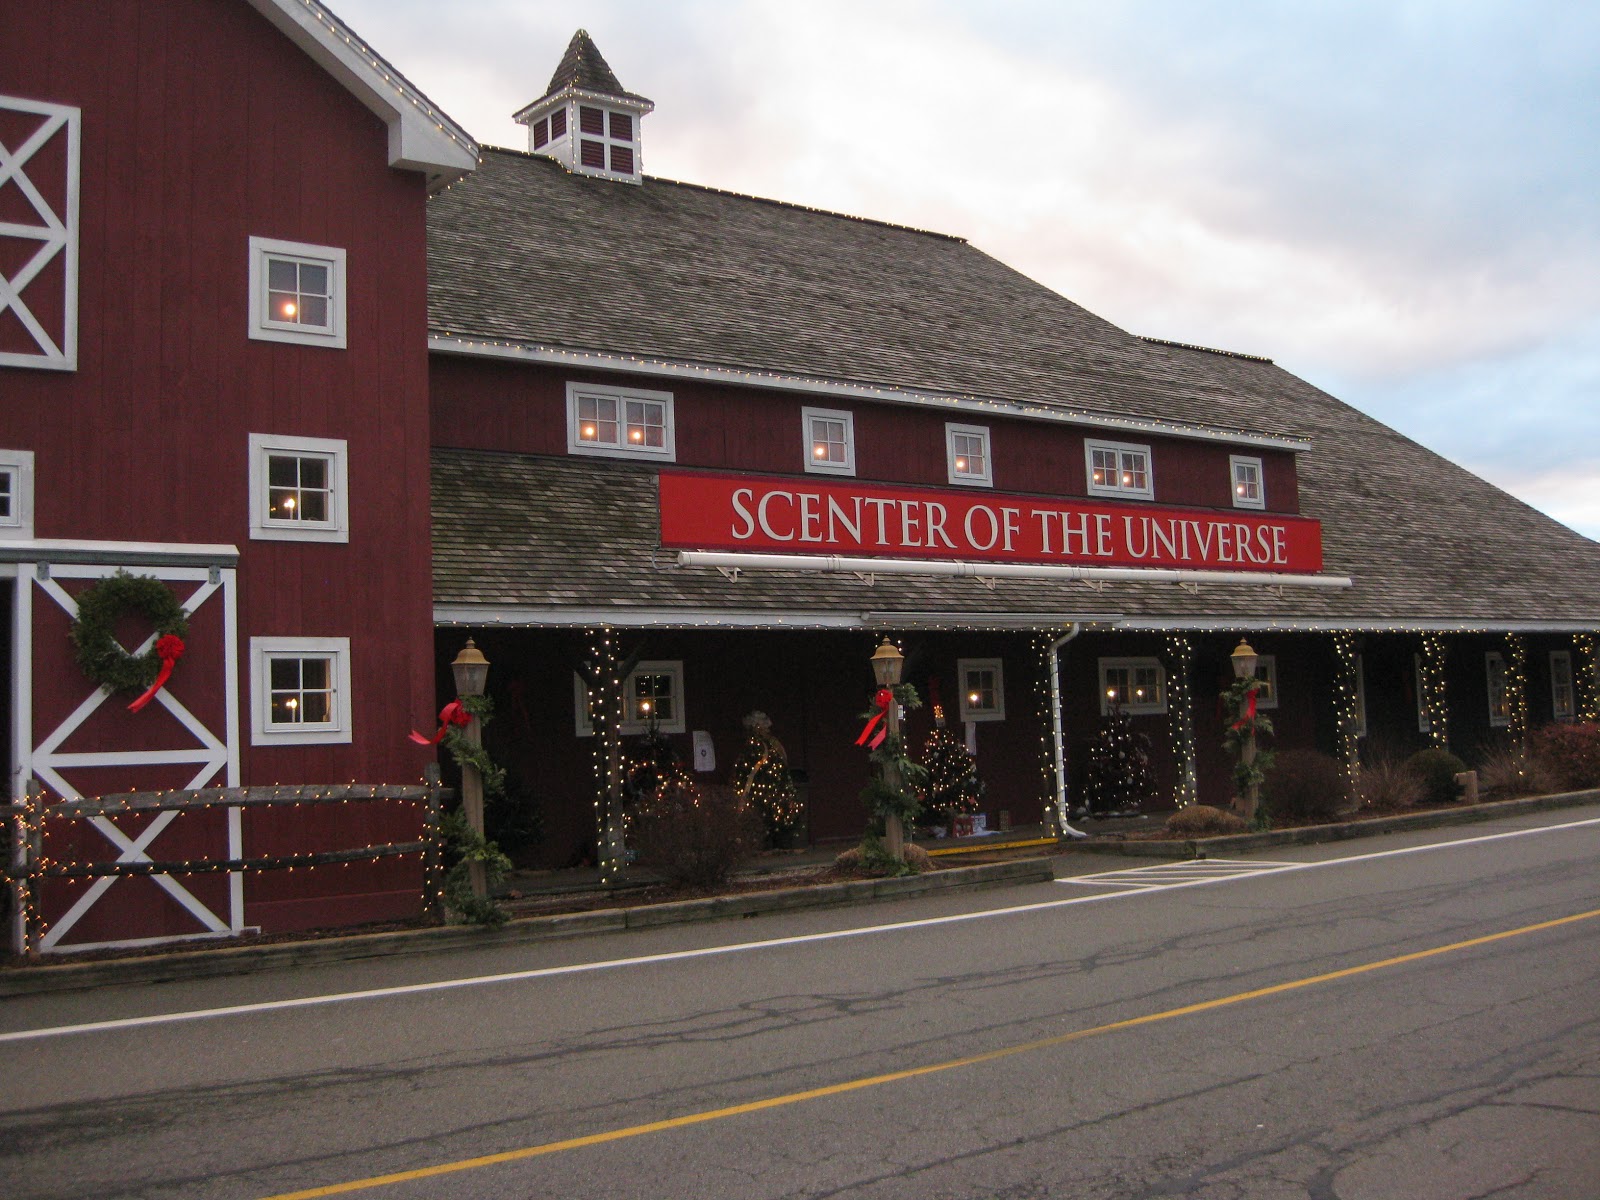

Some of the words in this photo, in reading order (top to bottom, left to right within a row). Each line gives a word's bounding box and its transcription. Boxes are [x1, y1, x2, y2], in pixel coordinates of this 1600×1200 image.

[731, 488, 958, 550] SCENTER
[964, 504, 1020, 552] OF
[1031, 509, 1113, 556] THE
[1122, 516, 1288, 565] UNIVERSE
